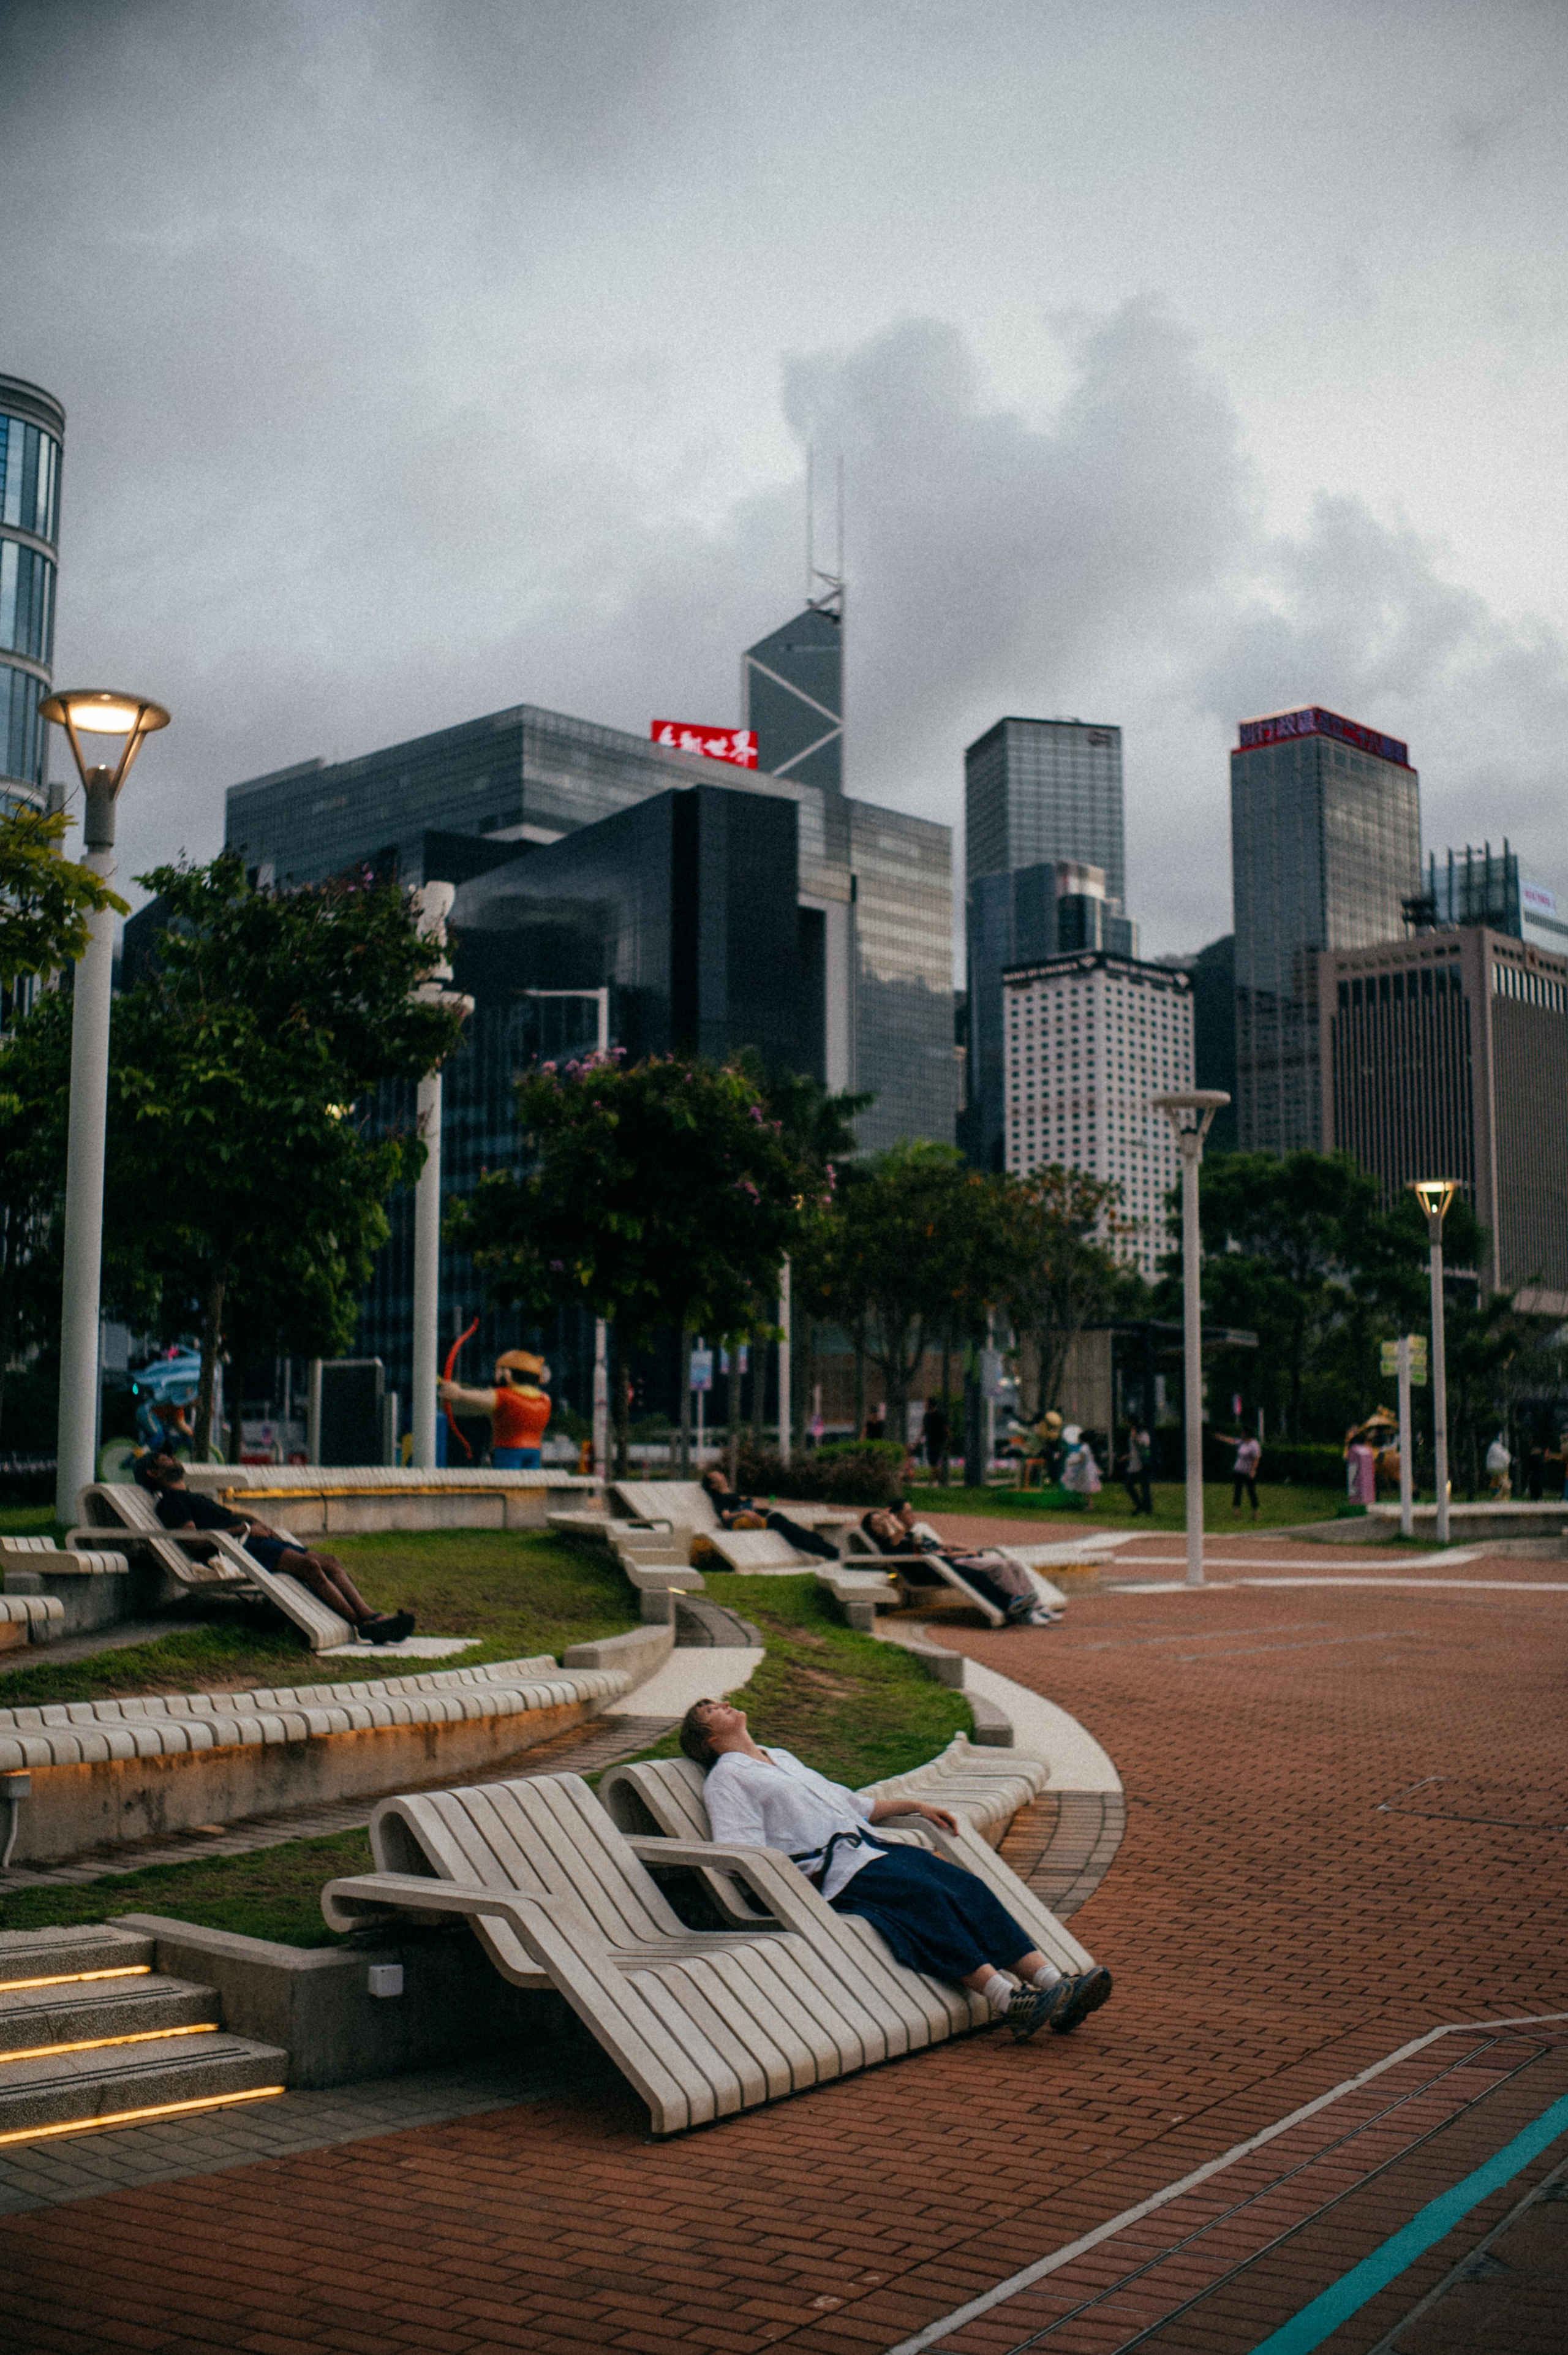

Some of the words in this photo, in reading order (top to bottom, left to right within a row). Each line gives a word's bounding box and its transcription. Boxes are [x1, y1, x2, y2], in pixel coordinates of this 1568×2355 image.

[1003, 972, 1026, 981] BANK
[1027, 969, 1038, 977] OF
[1040, 962, 1079, 975] AMERICA
